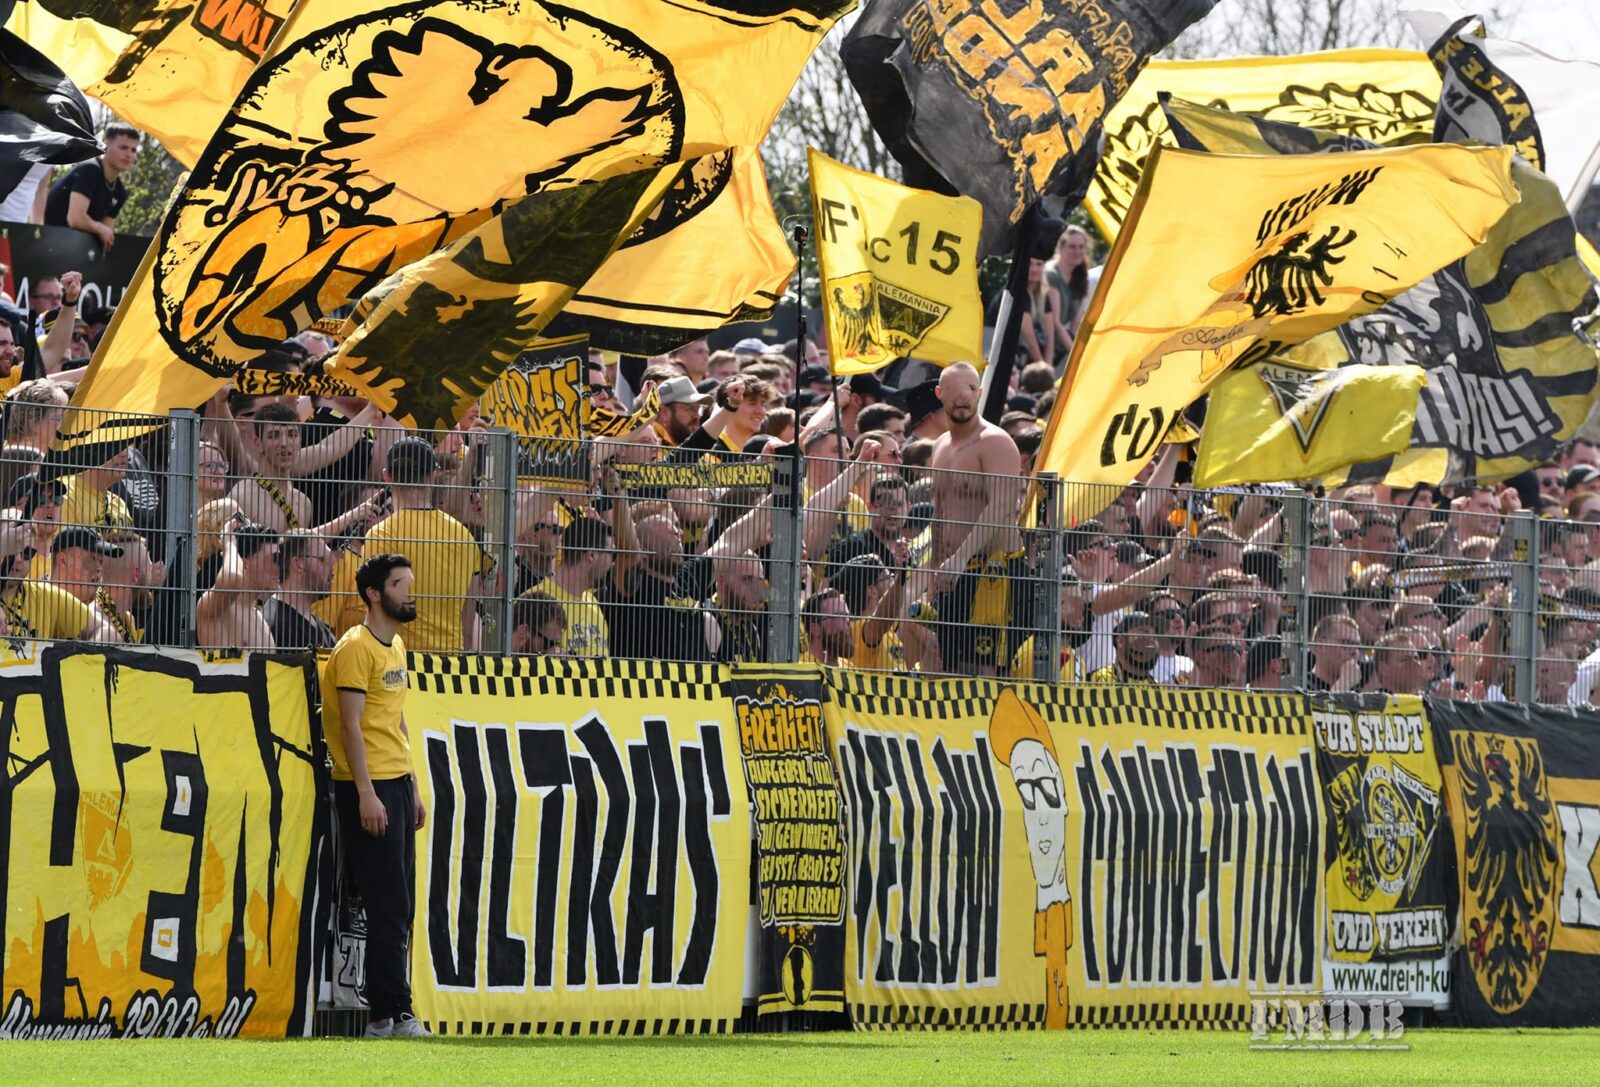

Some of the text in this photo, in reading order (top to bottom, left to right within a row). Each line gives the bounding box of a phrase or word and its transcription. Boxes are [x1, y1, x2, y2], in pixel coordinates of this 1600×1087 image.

[875, 284, 941, 315] ALEMANNIA
[737, 703, 823, 754] FREIHEIT
[1357, 713, 1424, 752] STADT
[756, 789, 840, 820] SICHERHEIT
[424, 710, 731, 990] ULTRAS
[838, 726, 1000, 988] YELLOW
[1076, 738, 1322, 988] CONNECTION
[775, 887, 841, 915] VERLIEREN
[1332, 910, 1444, 950] UND VEREIN
